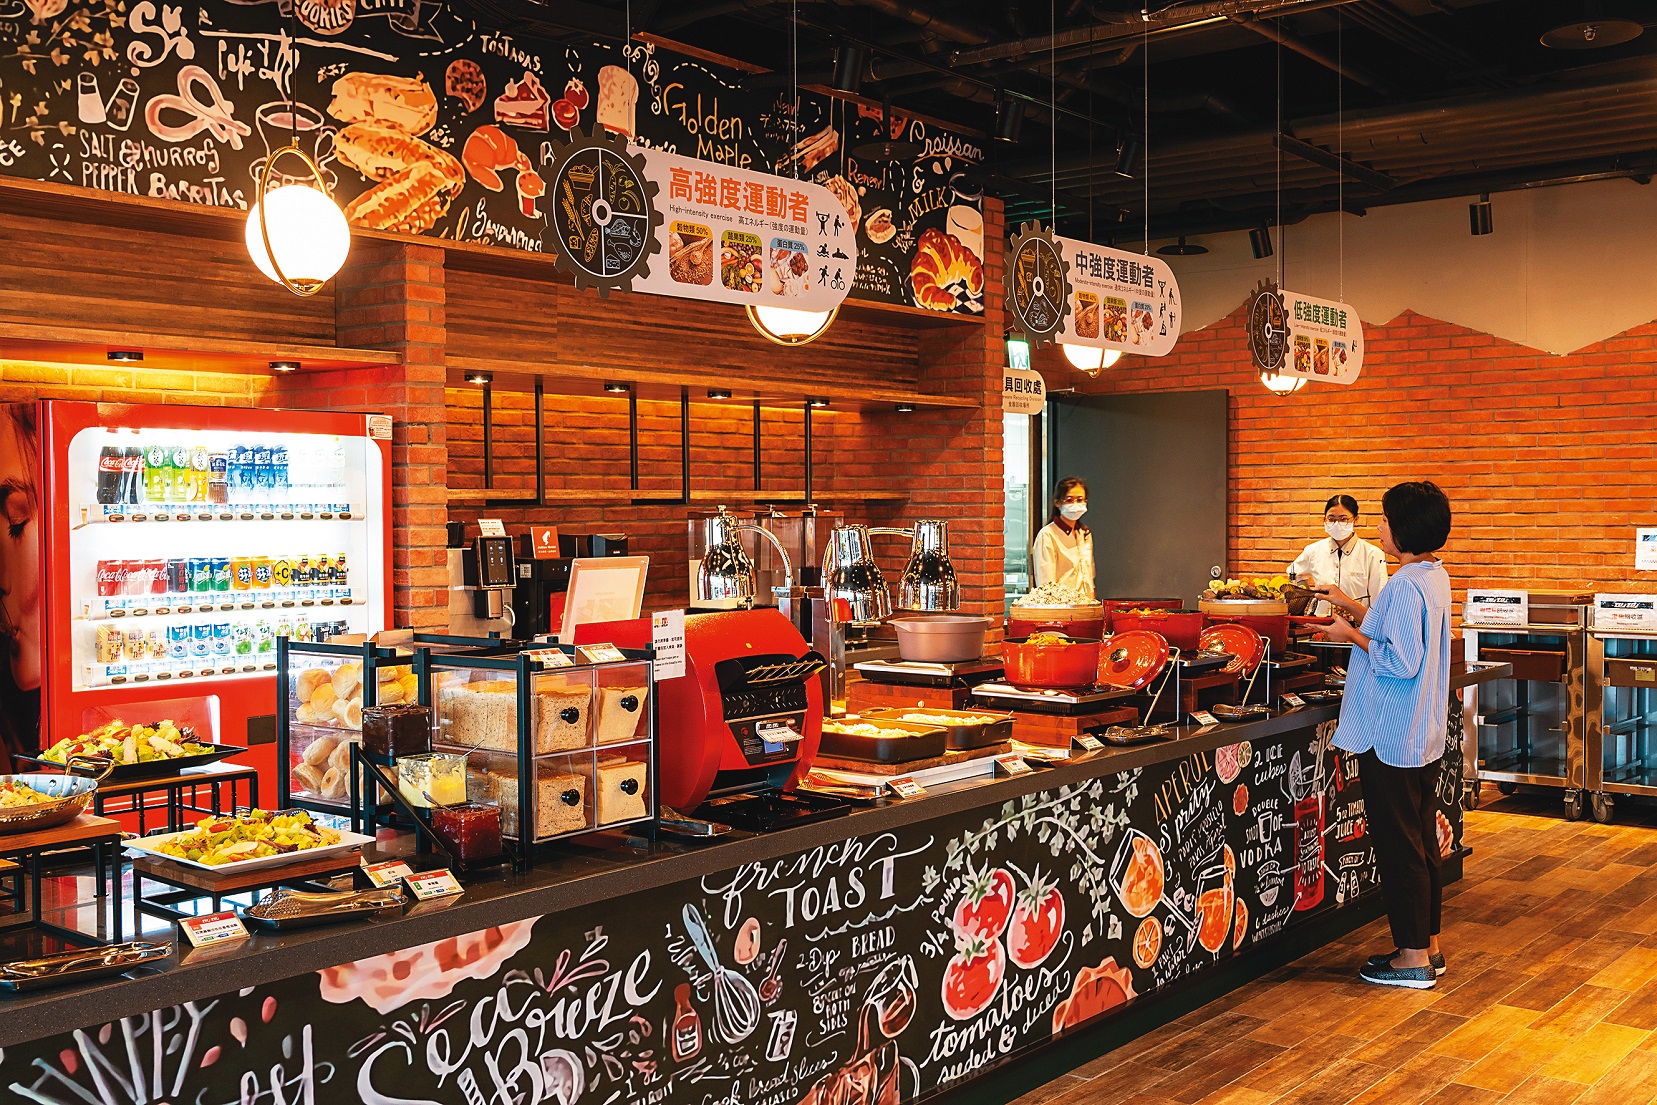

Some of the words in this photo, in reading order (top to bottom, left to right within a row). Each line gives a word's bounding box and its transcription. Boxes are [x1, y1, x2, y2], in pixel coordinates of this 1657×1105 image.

[663, 83, 743, 140] Golden
[80, 129, 116, 161] SALT
[696, 134, 752, 171] Maple
[82, 161, 139, 195] PEPPER
[669, 166, 809, 224] 高強度運動者
[908, 186, 949, 224] MILK
[669, 204, 709, 219] High-intensity
[710, 213, 734, 223] exercise
[695, 227, 709, 237] 50%
[1075, 250, 1155, 289] 中強度運動者
[1293, 299, 1347, 330] 低強度運動者
[1005, 376, 1042, 395] 具回收處
[1254, 751, 1263, 768] 2
[1254, 763, 1288, 787] cubes
[1251, 798, 1279, 817] DOUBLE
[1272, 813, 1283, 832] OF
[1336, 806, 1342, 822] 5
[1335, 819, 1353, 839] JUICE
[1239, 836, 1282, 869] VODKA
[768, 834, 935, 929] TOAST
[852, 925, 896, 958] BREAD
[920, 930, 1074, 1069] tomatoes
[936, 1040, 996, 1085] seeded
[998, 1023, 1018, 1054] &
